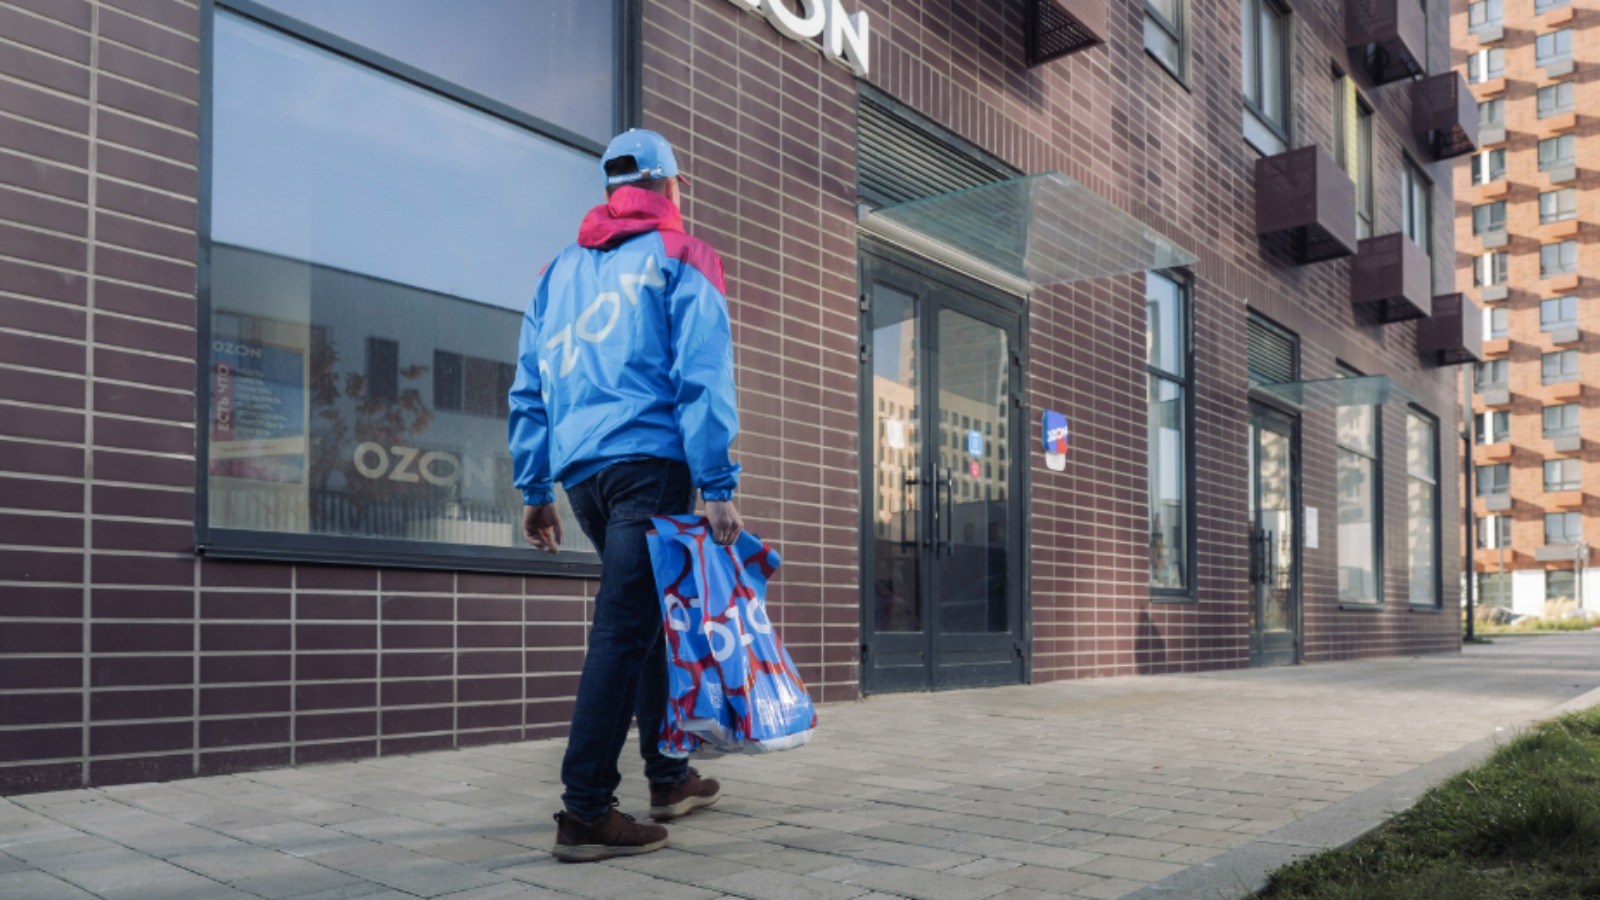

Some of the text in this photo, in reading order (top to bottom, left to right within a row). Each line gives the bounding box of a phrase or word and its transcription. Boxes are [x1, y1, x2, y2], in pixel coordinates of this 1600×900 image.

[740, 0, 869, 77] ON
[212, 341, 262, 358] OZON
[217, 364, 230, 431] ЕСТЬ ЧТО
[354, 441, 495, 488] OZON
